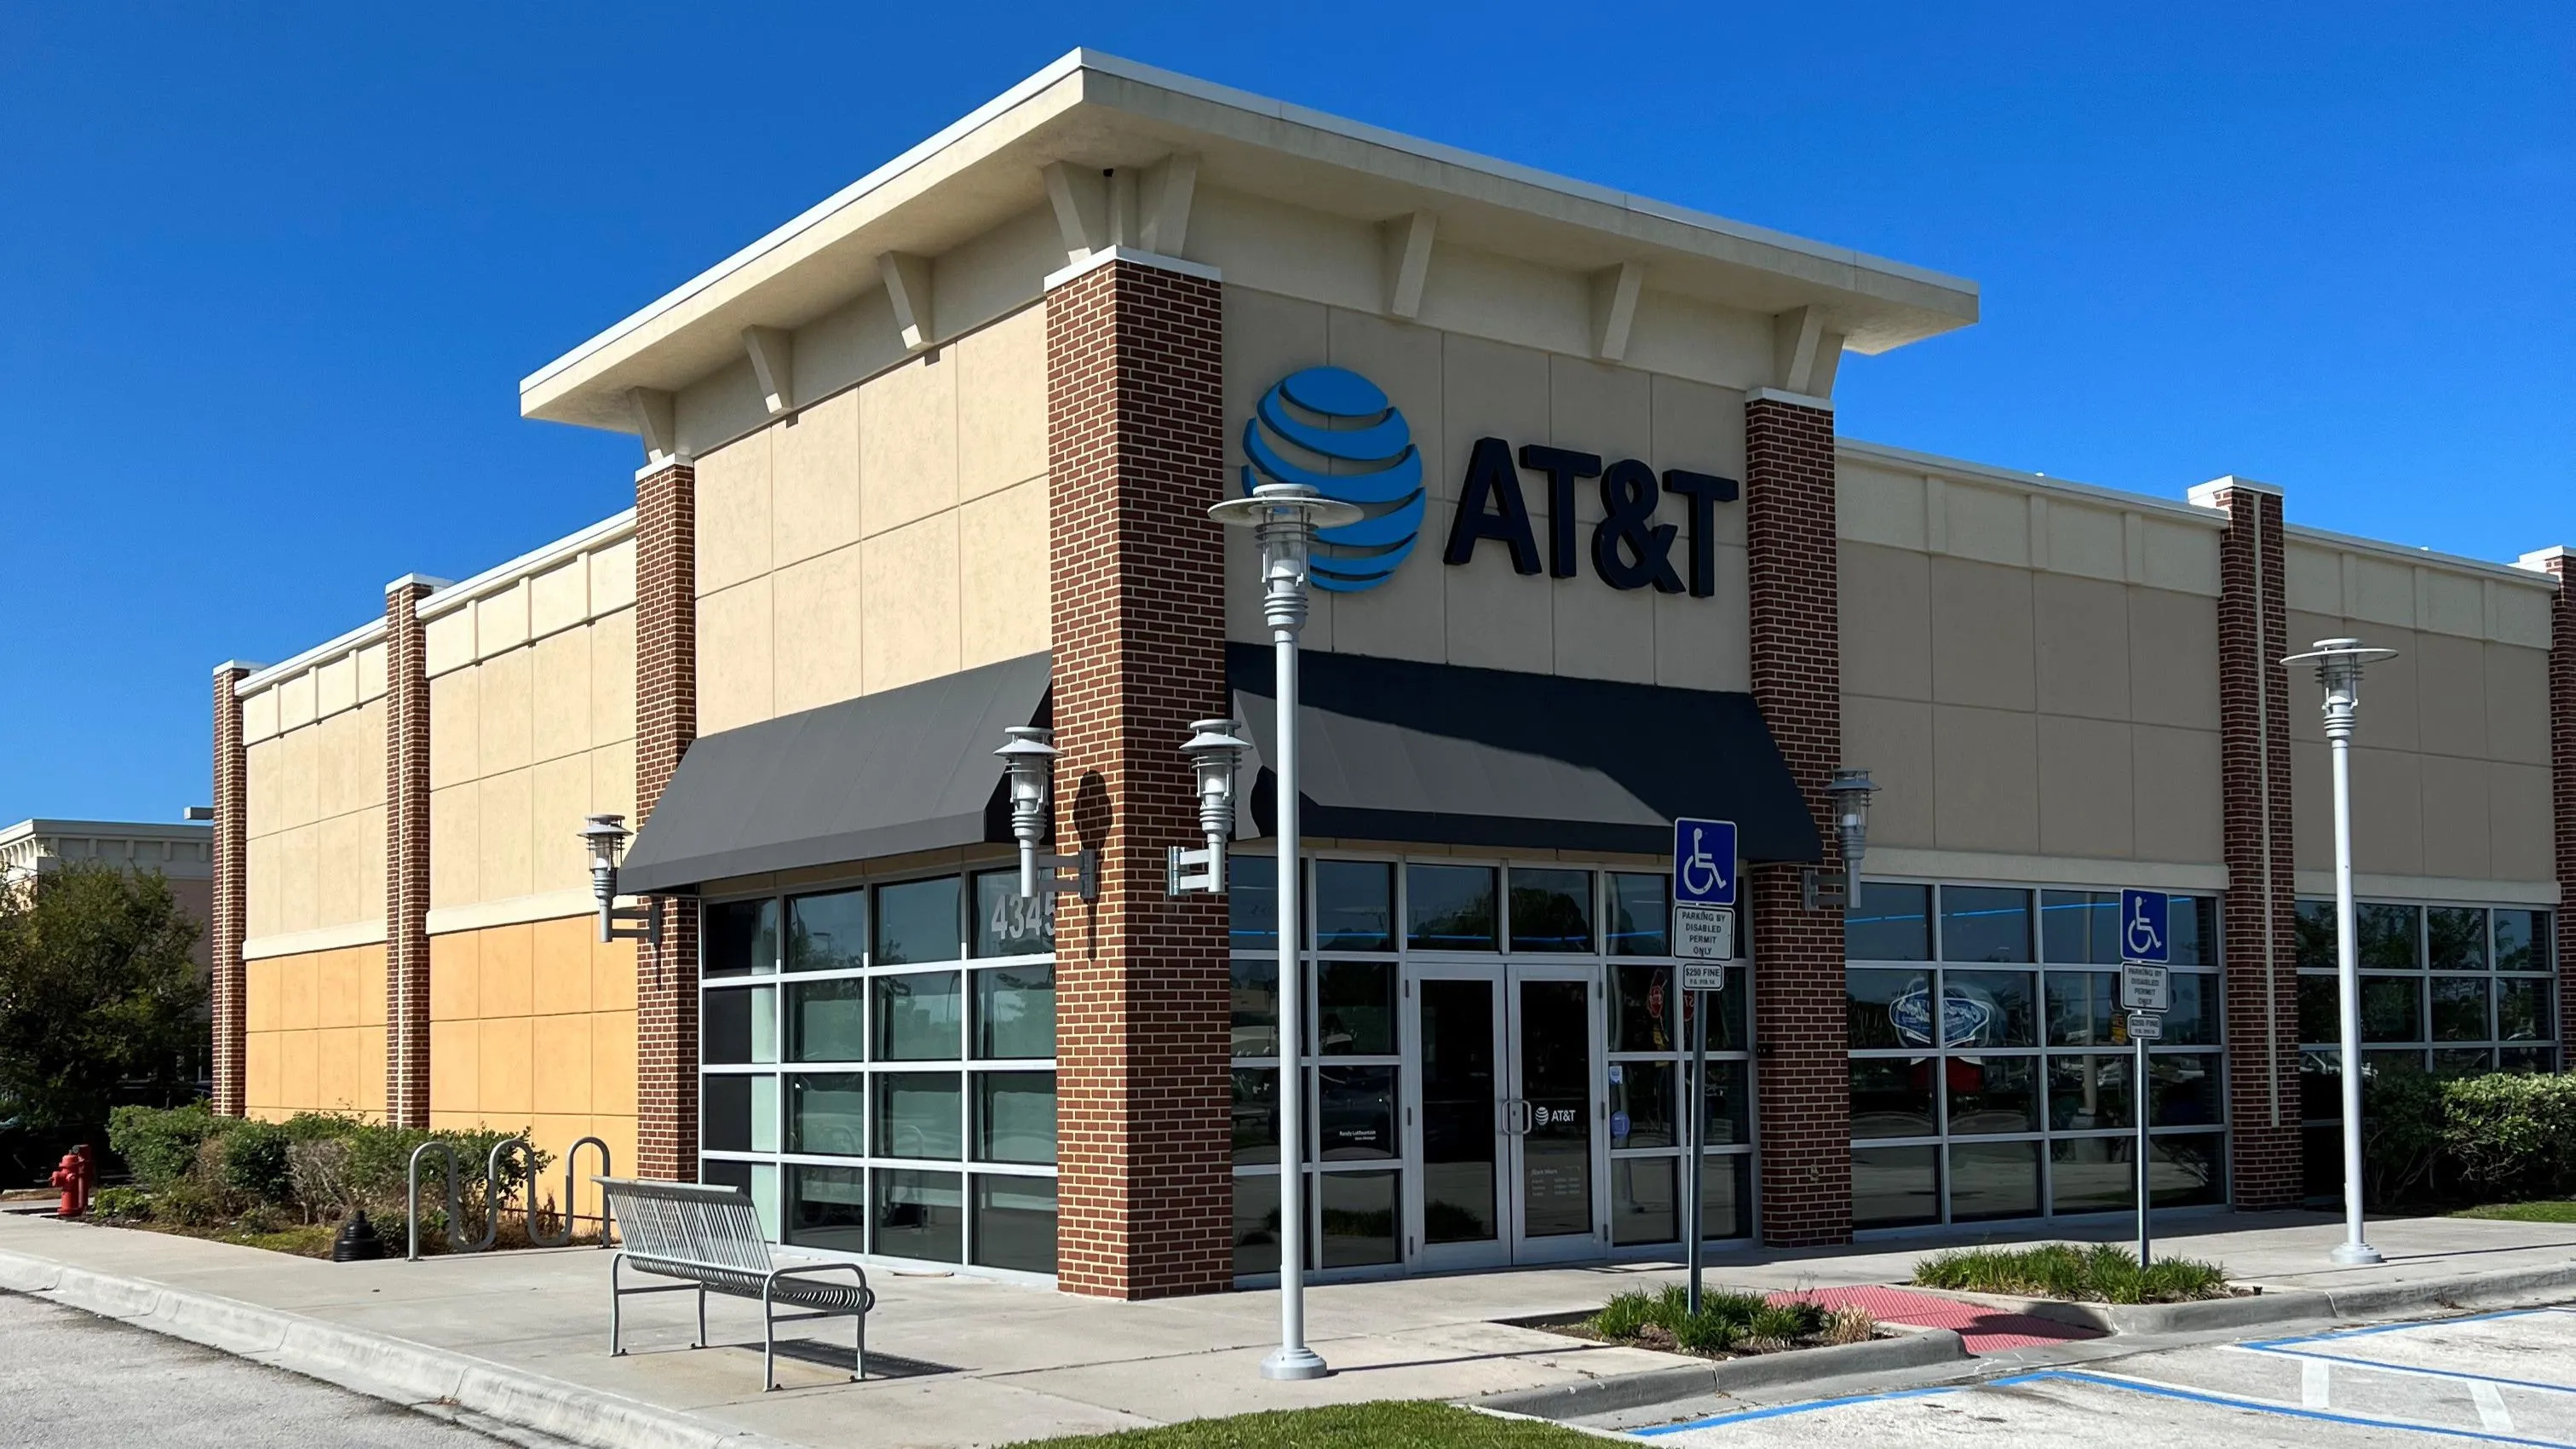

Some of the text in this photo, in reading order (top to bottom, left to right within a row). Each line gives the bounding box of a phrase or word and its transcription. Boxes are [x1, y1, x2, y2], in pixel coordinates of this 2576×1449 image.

[1443, 436, 1739, 598] AT&T
[991, 891, 1055, 940] 4345
[1682, 911, 1726, 923] PARKING BY
[1686, 923, 1721, 933] DISABLED
[1689, 934, 1717, 944] PERMIT
[1693, 946, 1712, 956] ONLY
[1686, 968, 1721, 977] $250 FINE
[1550, 1109, 1577, 1123] AT&T
